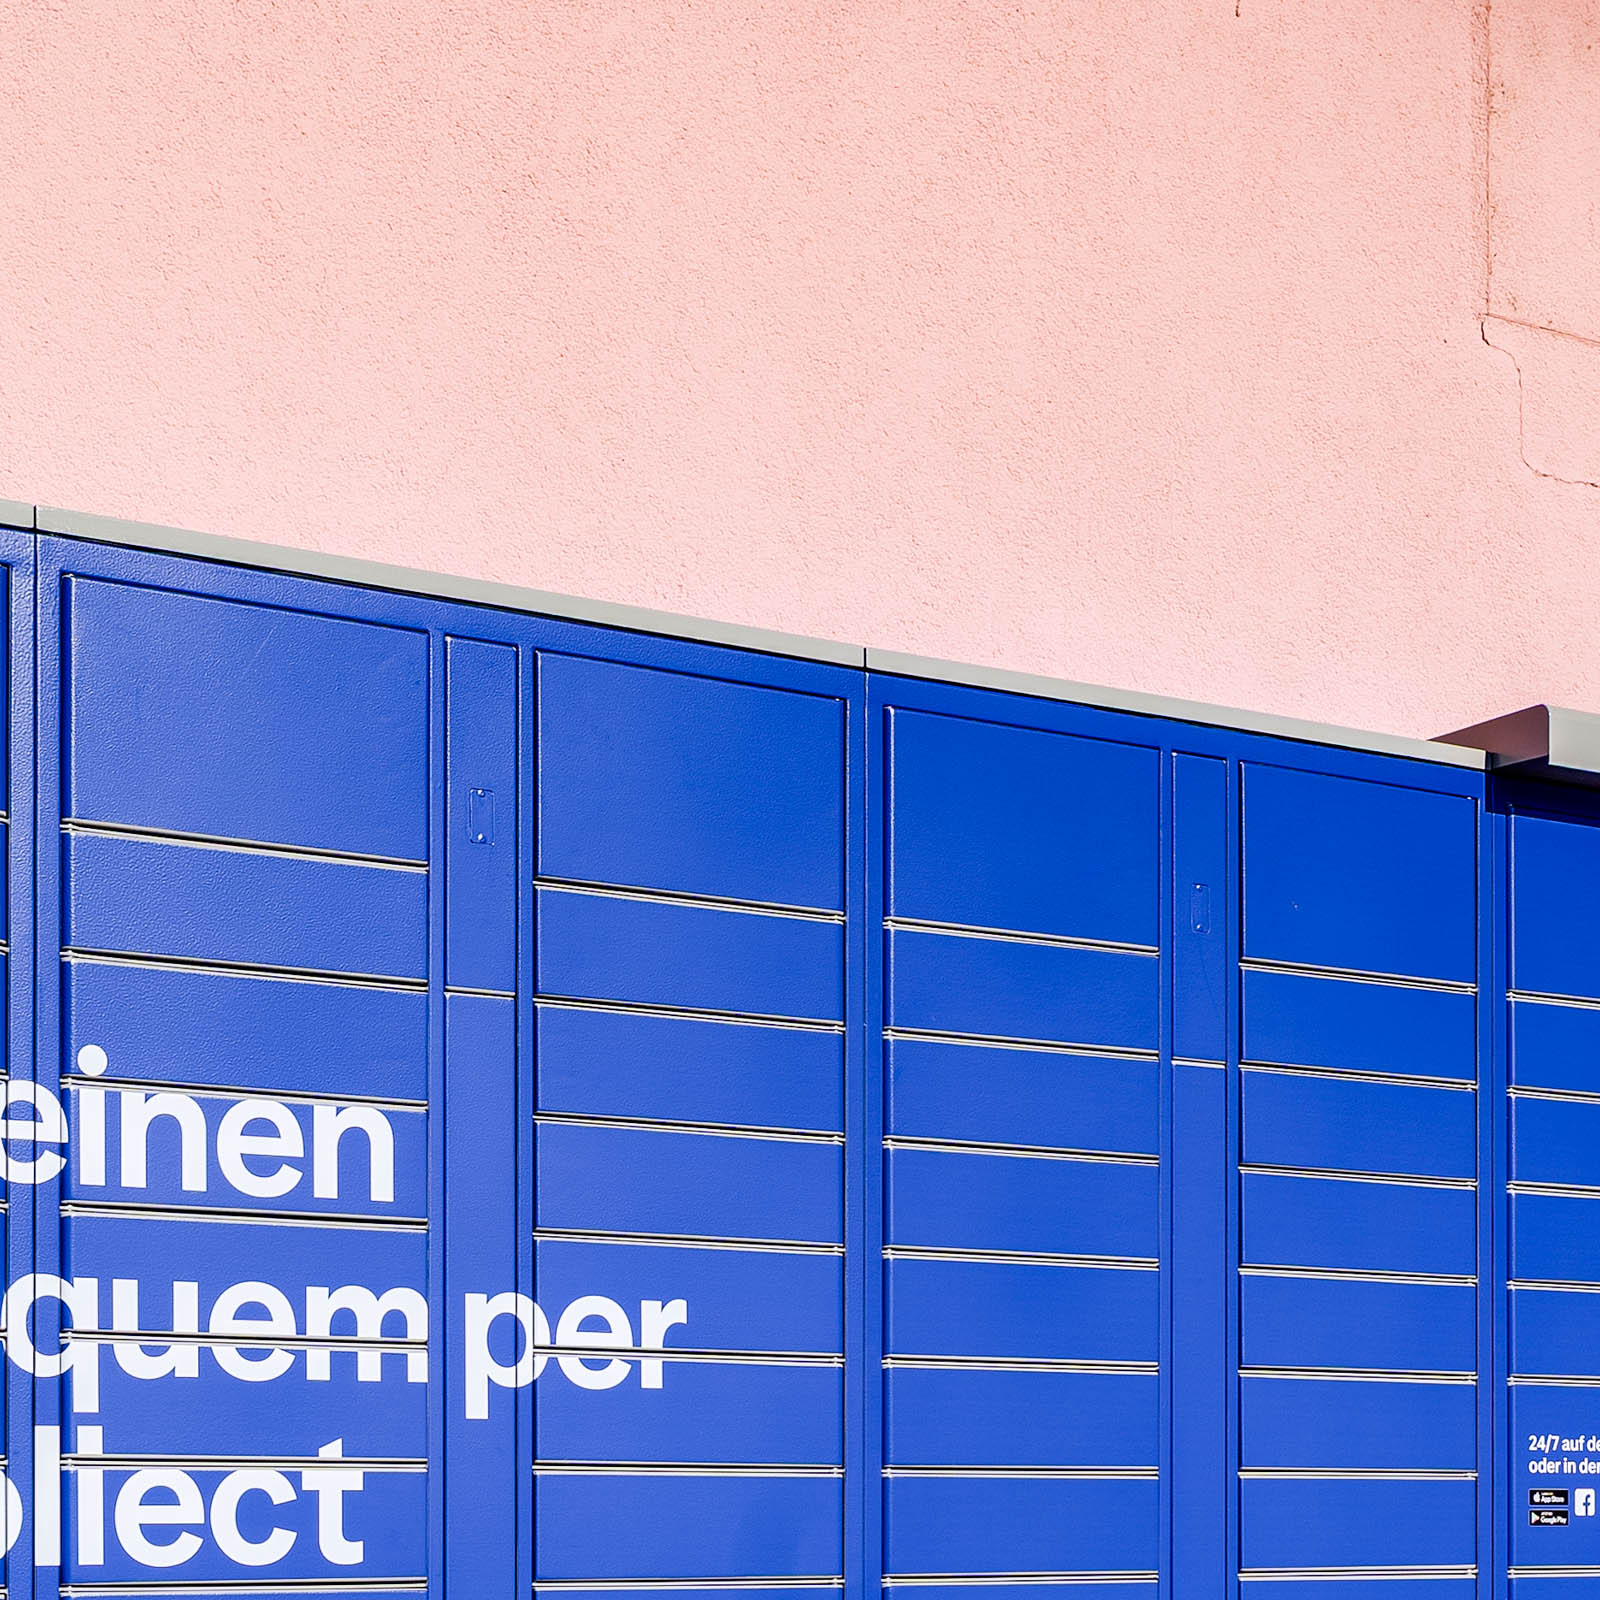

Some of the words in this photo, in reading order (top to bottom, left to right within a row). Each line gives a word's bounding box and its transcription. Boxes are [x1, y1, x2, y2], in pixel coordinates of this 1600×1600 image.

[464, 1290, 688, 1420] per
[1528, 1434, 1560, 1453] 24/7
[1561, 1435, 1586, 1452] auf
[1528, 1457, 1561, 1474] oder
[1563, 1457, 1576, 1474] in
